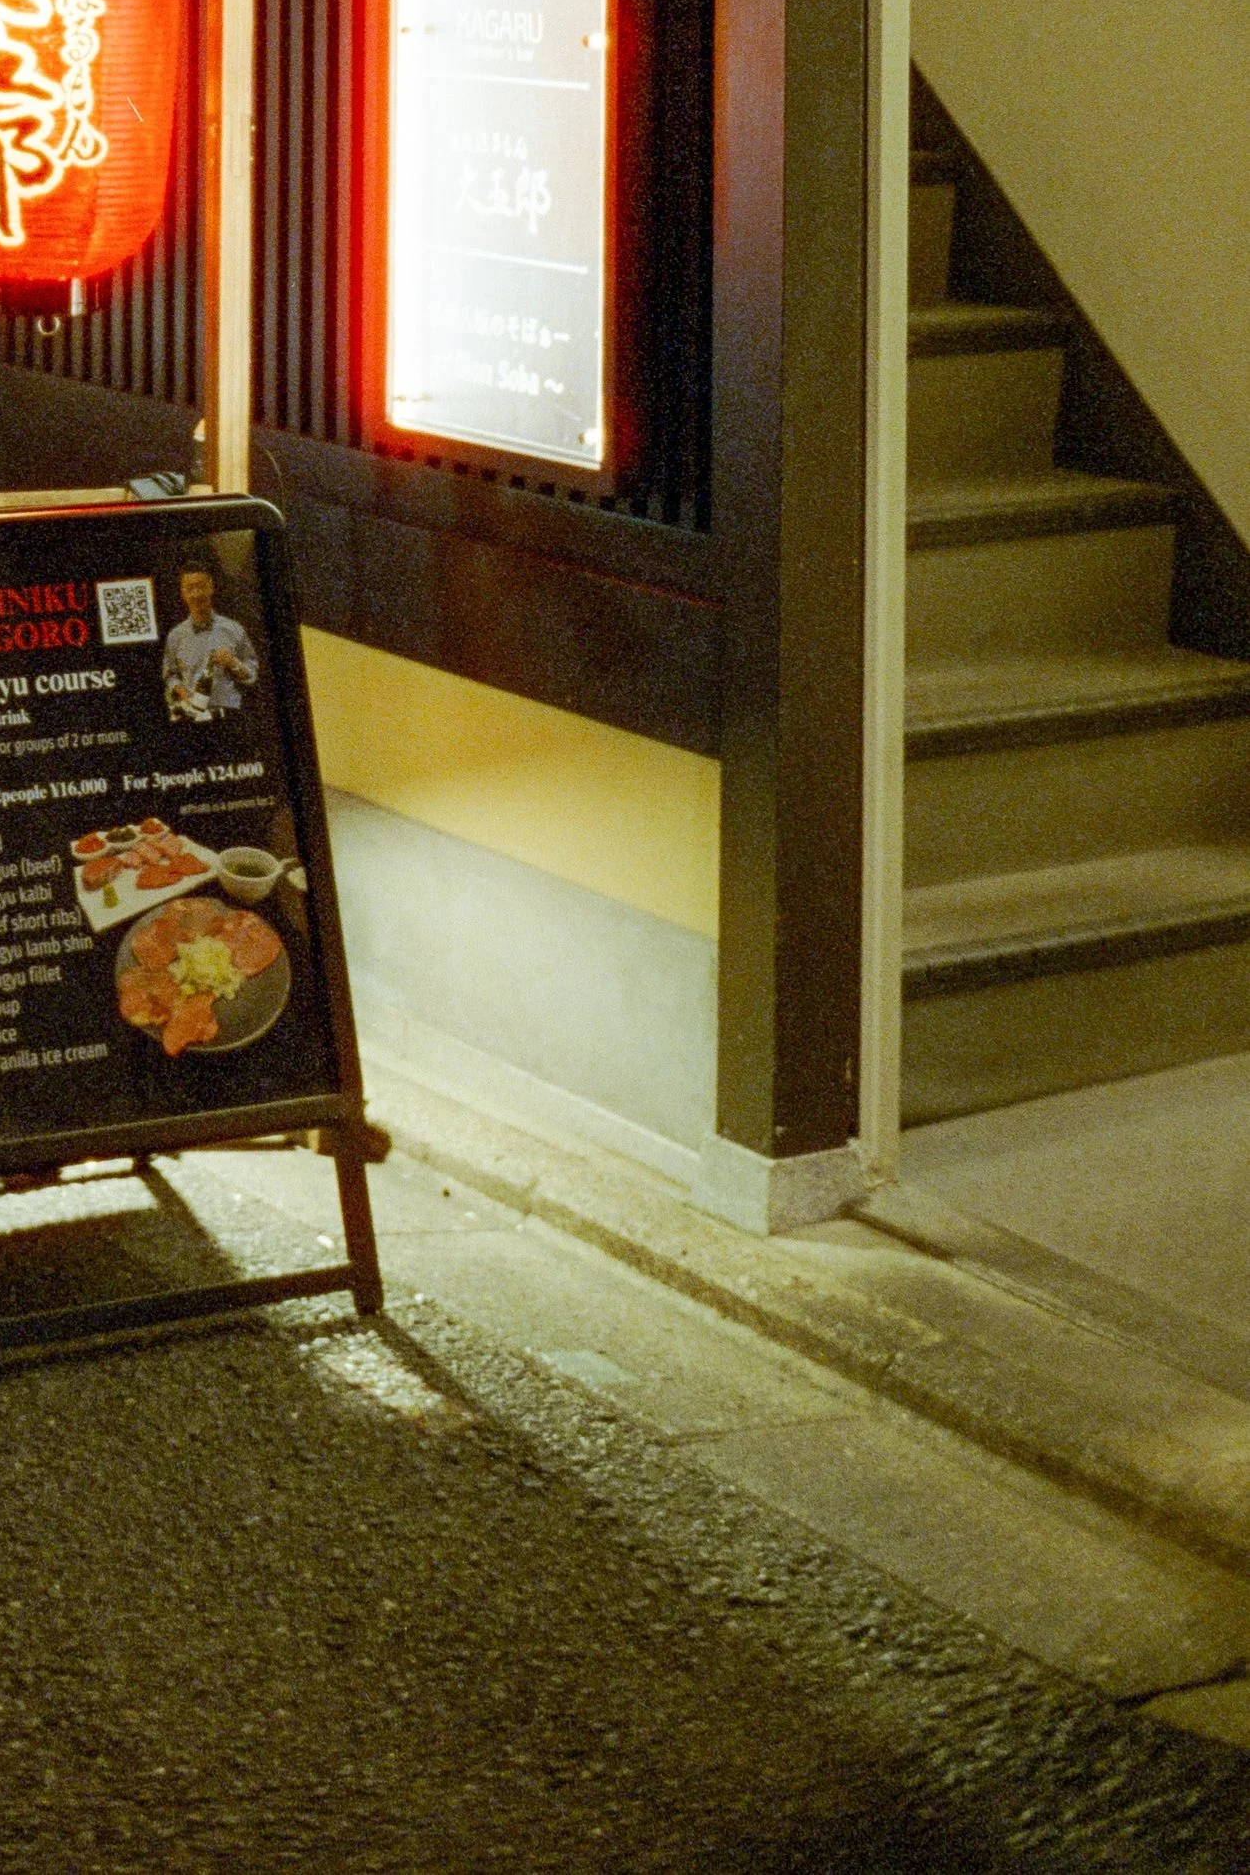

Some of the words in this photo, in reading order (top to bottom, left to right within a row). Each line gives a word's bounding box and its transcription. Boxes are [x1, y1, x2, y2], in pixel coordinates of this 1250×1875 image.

[35, 668, 116, 694] course
[13, 737, 55, 755] groups
[57, 733, 71, 749] of
[72, 734, 79, 748] 2
[81, 734, 93, 746] or
[122, 774, 149, 792] For
[152, 768, 206, 790] 3people
[20, 855, 62, 877] (beef)
[18, 882, 53, 903] kalbi
[10, 912, 50, 932] short
[51, 905, 83, 926] ribs)
[25, 935, 62, 956] lamb
[63, 933, 93, 953] shin
[29, 964, 63, 983] fillet
[41, 1046, 63, 1065] ice
[64, 1042, 109, 1063] cream
